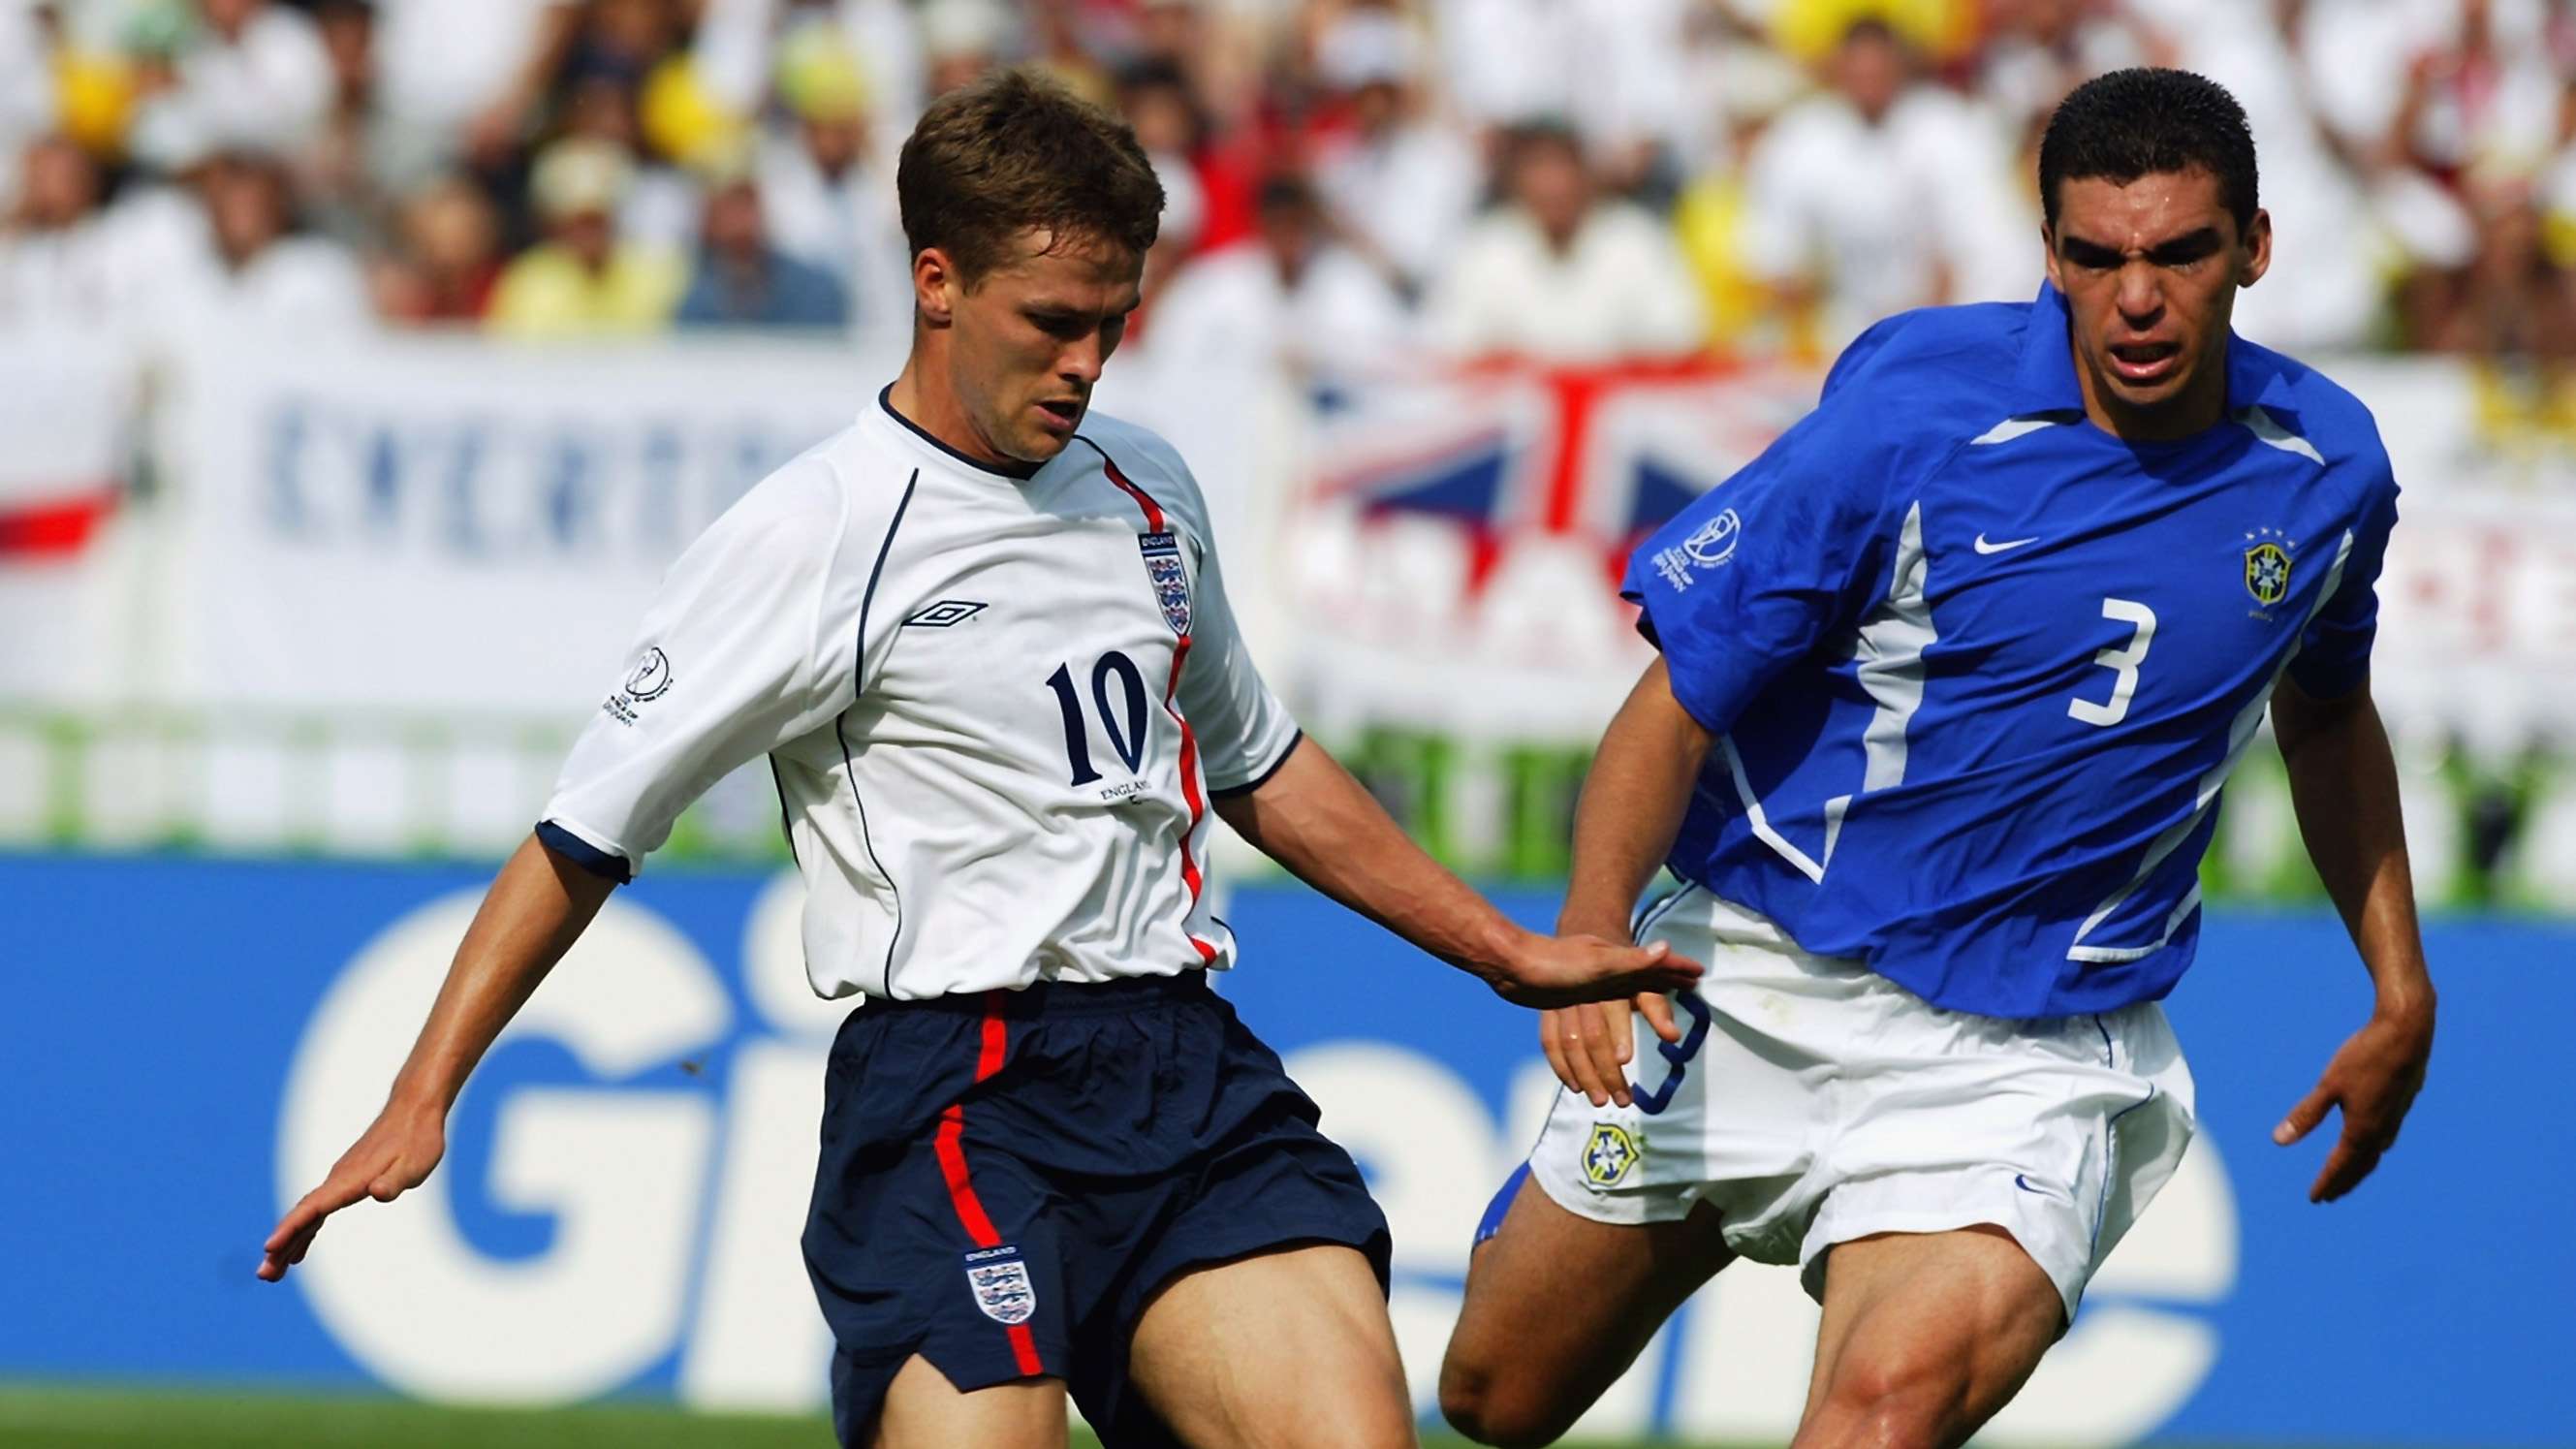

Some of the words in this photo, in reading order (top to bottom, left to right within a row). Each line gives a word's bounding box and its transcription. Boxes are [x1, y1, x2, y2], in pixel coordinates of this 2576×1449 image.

[1046, 650, 1147, 787] 10
[2067, 597, 2156, 727] 3
[1631, 989, 1712, 1116] 3
